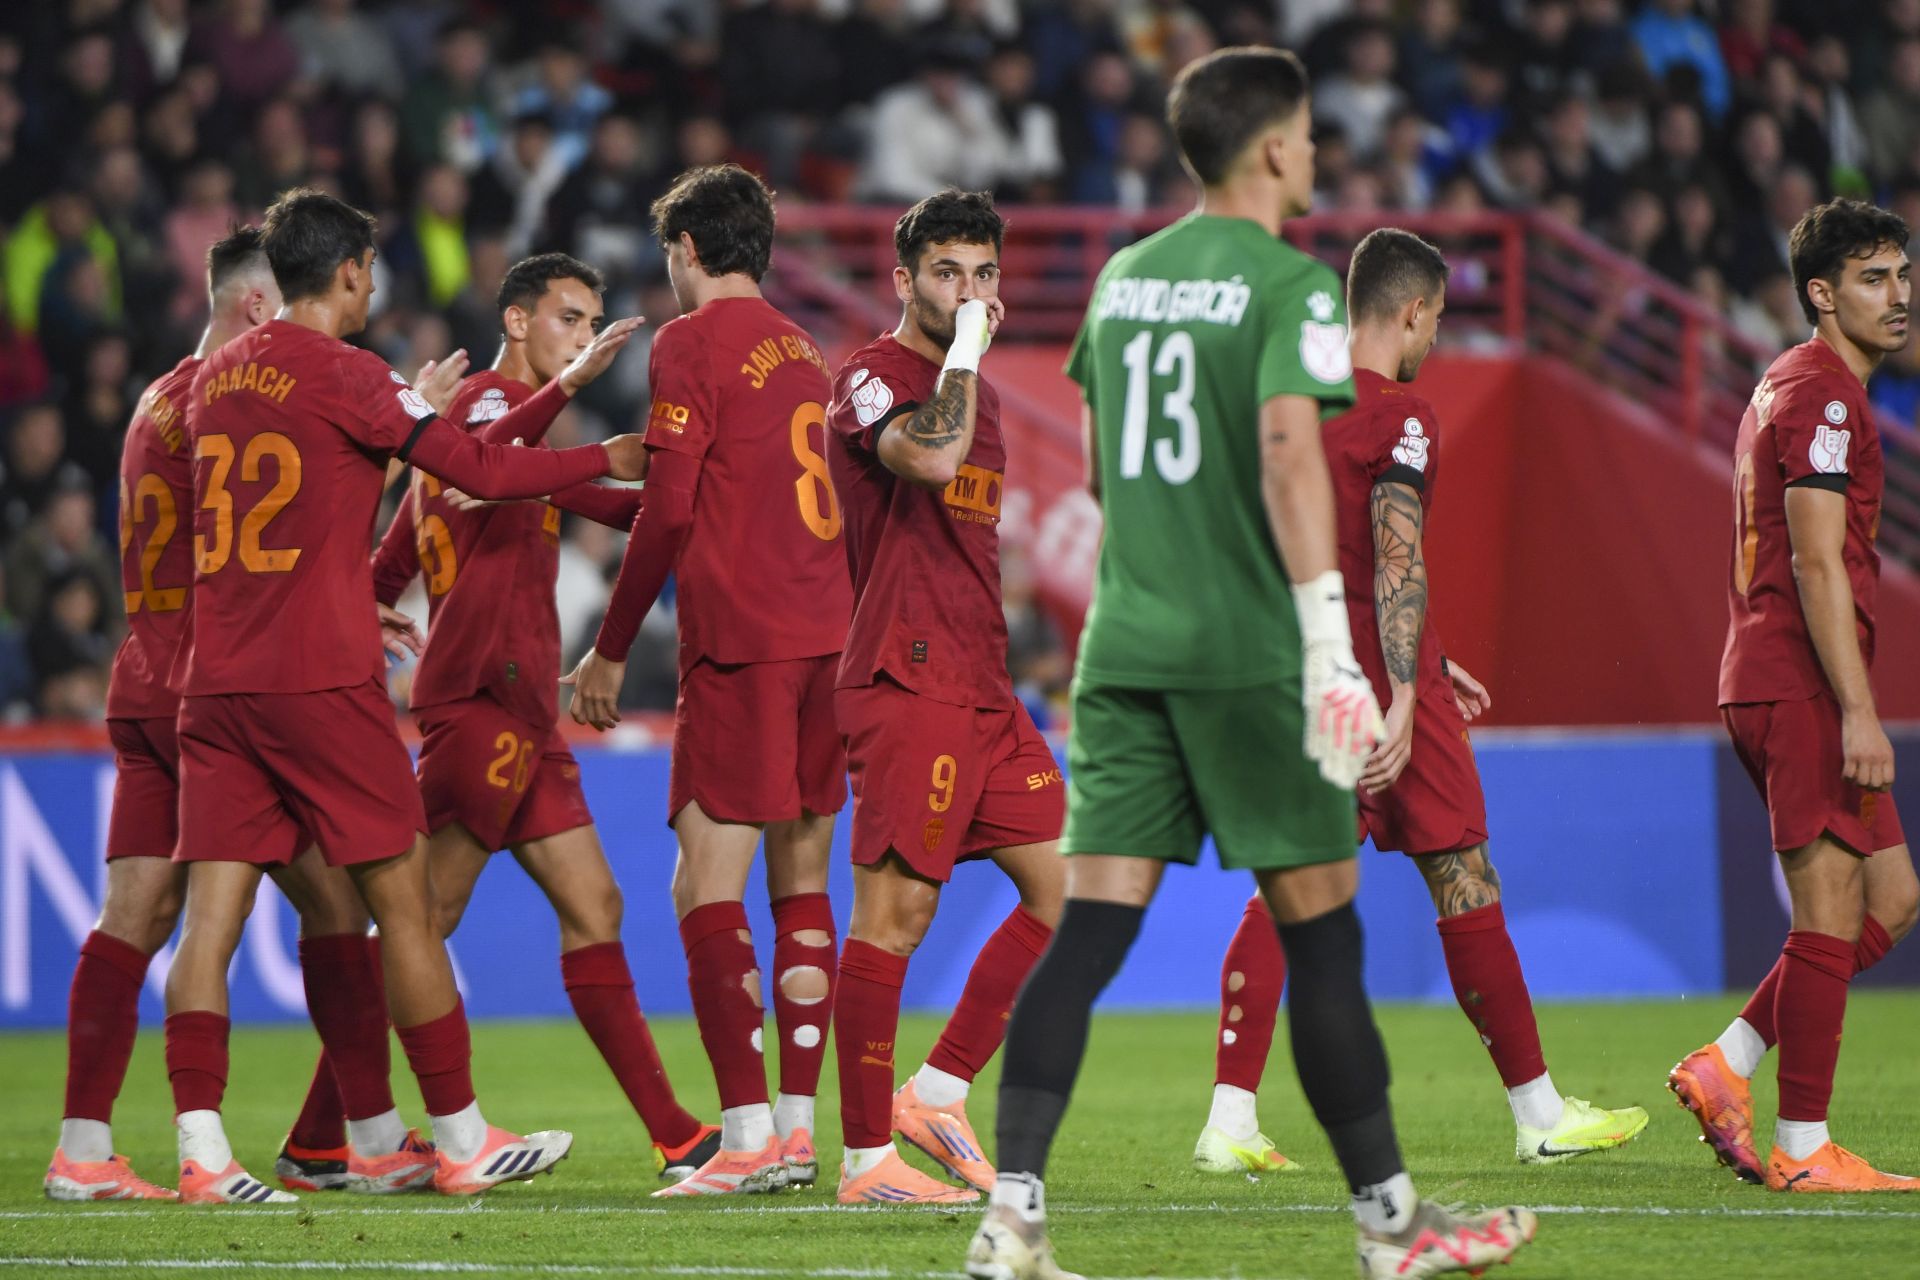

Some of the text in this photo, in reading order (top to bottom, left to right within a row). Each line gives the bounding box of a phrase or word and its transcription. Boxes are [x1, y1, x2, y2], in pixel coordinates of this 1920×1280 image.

[205, 362, 297, 405] PANACH
[741, 338, 785, 389] JAVI
[1120, 330, 1202, 485] 13
[194, 432, 302, 574] 32
[791, 401, 841, 541] 8
[928, 754, 957, 812] 9
